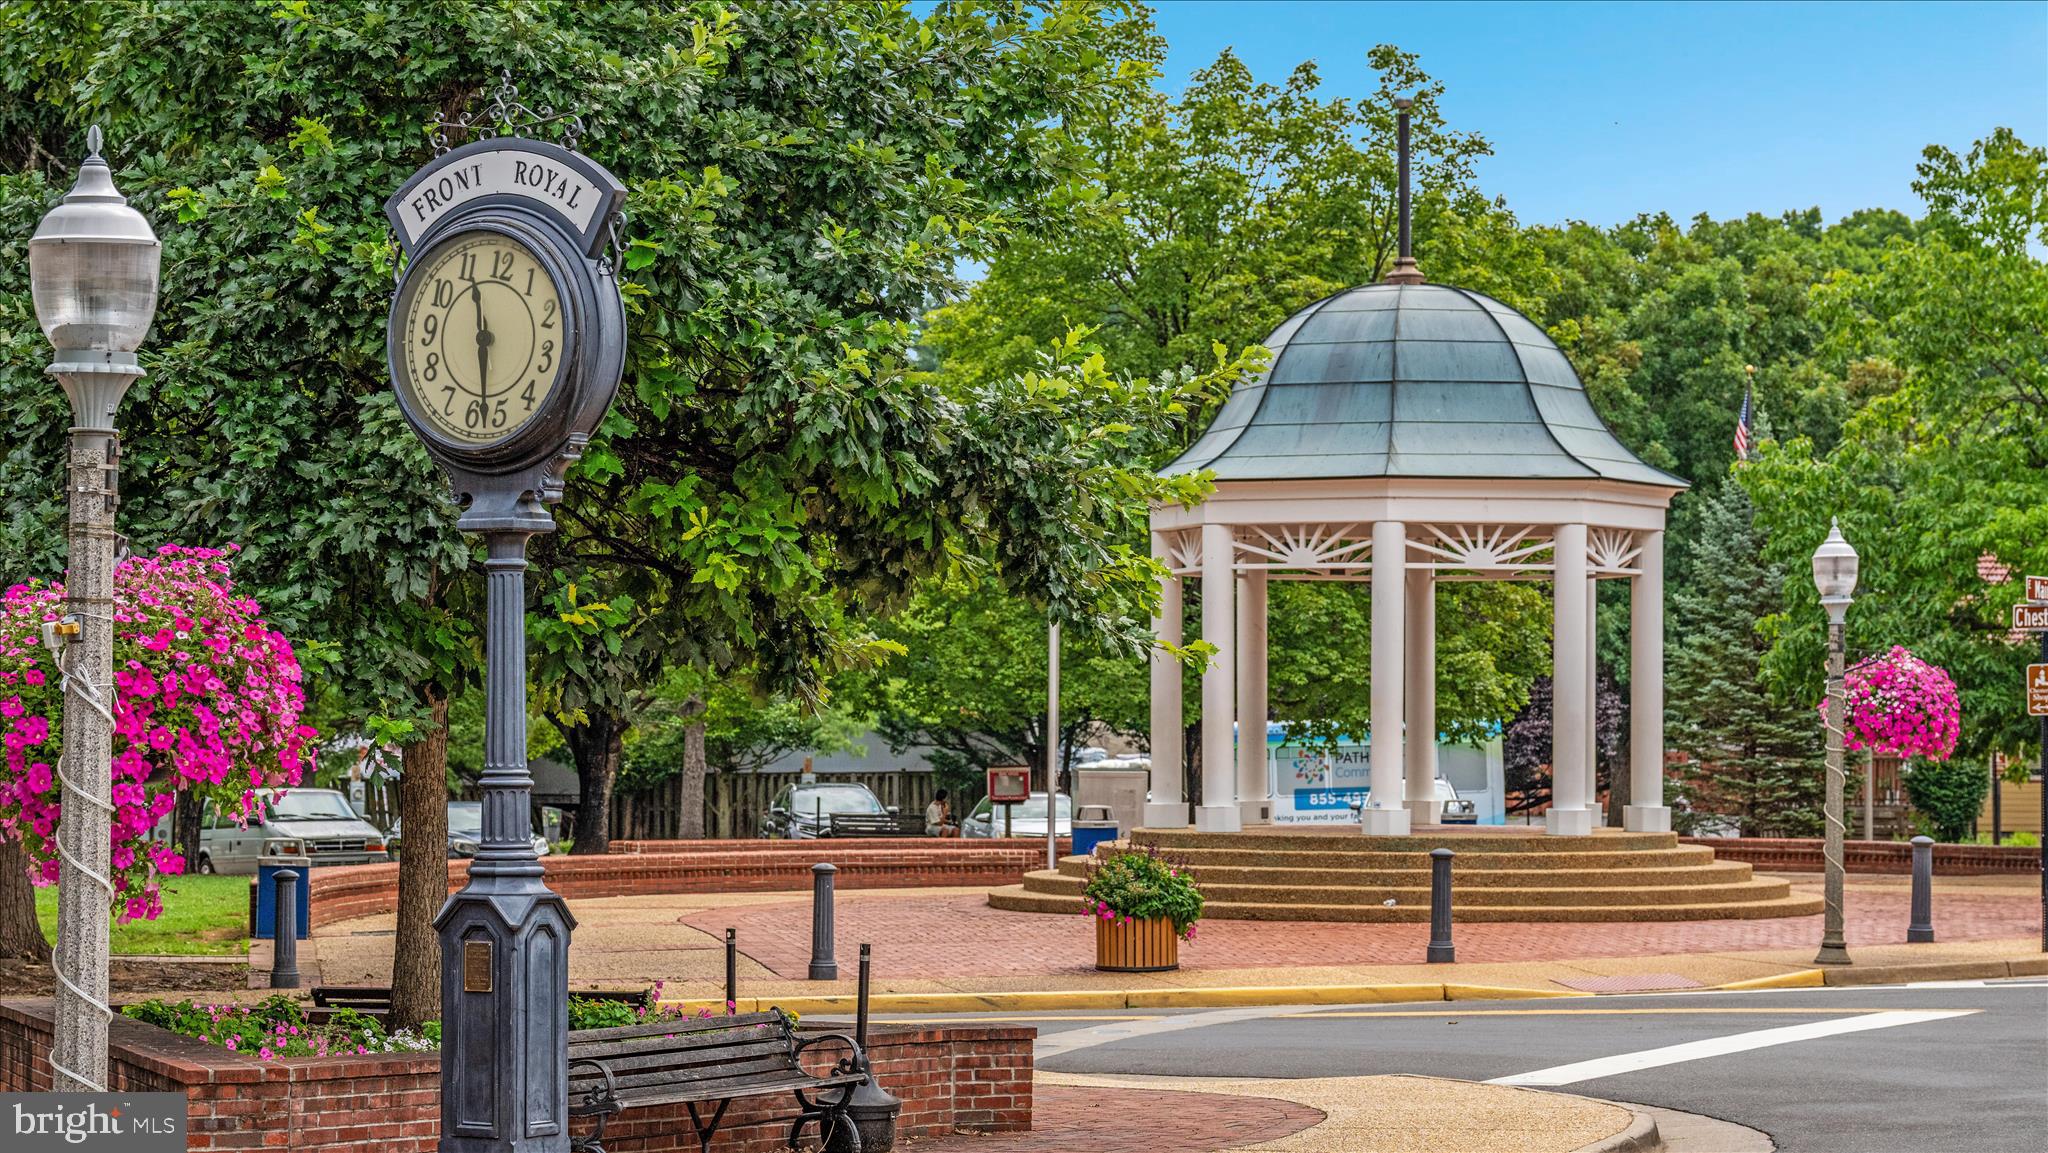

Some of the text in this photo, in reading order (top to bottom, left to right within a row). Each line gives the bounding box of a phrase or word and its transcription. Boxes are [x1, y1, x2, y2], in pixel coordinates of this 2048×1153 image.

[412, 160, 582, 222] FRONT ROYAL
[458, 252, 477, 282] 11
[490, 251, 514, 282] 12
[431, 278, 453, 309] 10
[525, 268, 535, 297] 1
[541, 299, 556, 329] 2
[421, 314, 438, 346] 9
[423, 352, 439, 382] 8
[538, 340, 554, 373] 3
[441, 385, 456, 416] 7
[521, 379, 536, 411] 4
[465, 400, 480, 429] 6
[492, 398, 508, 428] 5
[1313, 813, 1328, 821] and
[1330, 814, 1348, 822] your
